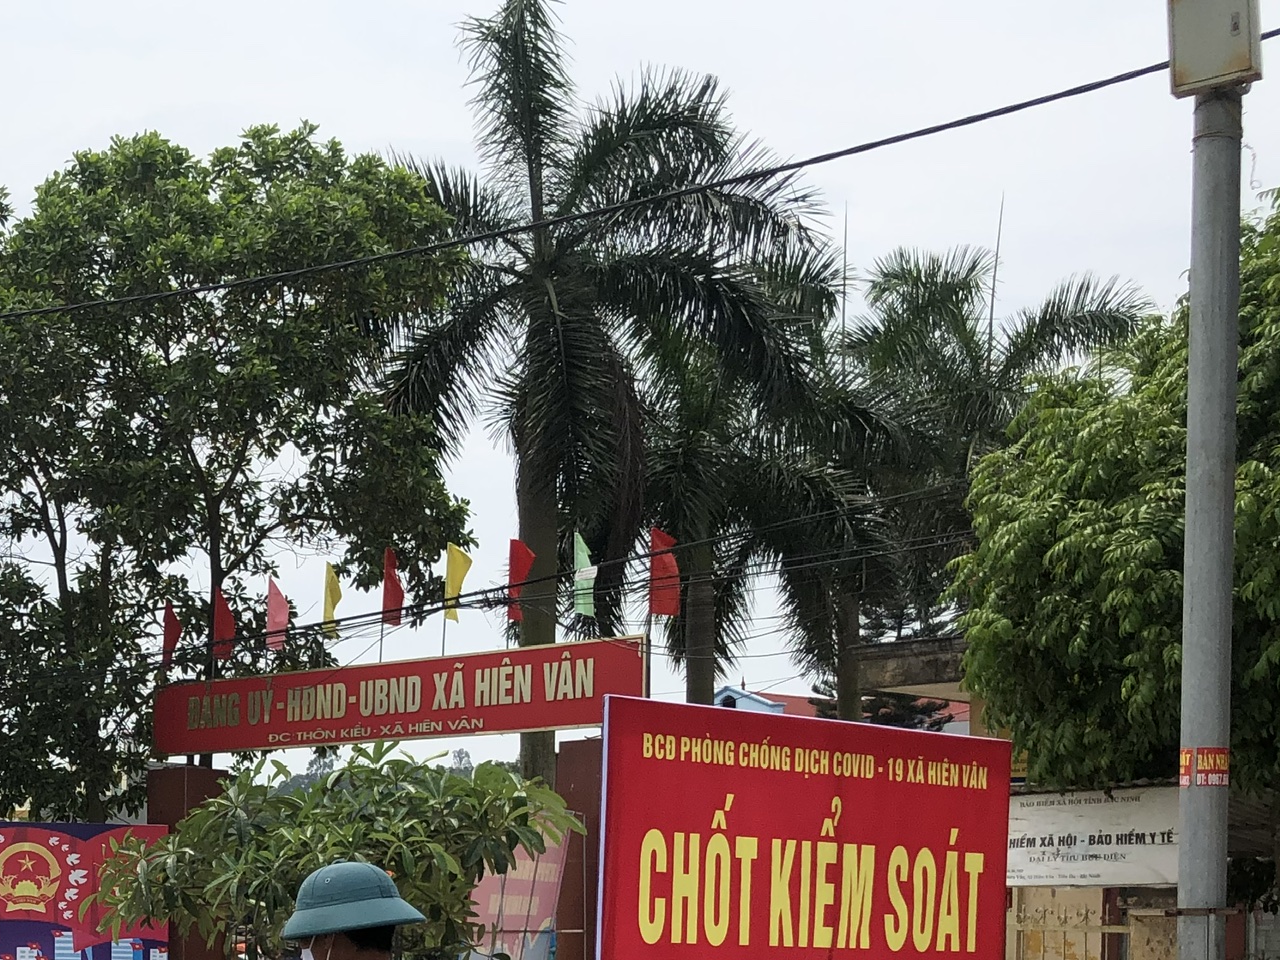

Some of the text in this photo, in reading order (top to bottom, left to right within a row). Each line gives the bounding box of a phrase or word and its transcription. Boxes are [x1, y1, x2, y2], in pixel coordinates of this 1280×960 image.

[432, 662, 465, 711] XÃ
[475, 657, 532, 707] HIÊN
[543, 651, 594, 702] VÂN
[297, 728, 336, 741] THÔN
[380, 721, 405, 735] XÃ
[408, 719, 443, 733] HIÊN
[447, 715, 484, 730] VÂN
[642, 732, 676, 761] BCĐ
[680, 738, 735, 767] PHÒNG
[738, 735, 791, 772] CHỐNG
[794, 748, 830, 778] DỊCH
[832, 753, 875, 779] COVID
[888, 759, 904, 781] 19
[906, 757, 926, 784] XÃ
[928, 761, 959, 788] HIÊN
[962, 762, 988, 790] VÂN
[1039, 834, 1054, 848] XÃ
[1058, 833, 1077, 849] HỘI
[1088, 829, 1112, 846] BẢO
[1115, 828, 1146, 845] HIỂM
[1149, 832, 1157, 844] Y
[638, 794, 985, 953] CHỐT KIỂM SOÁT
